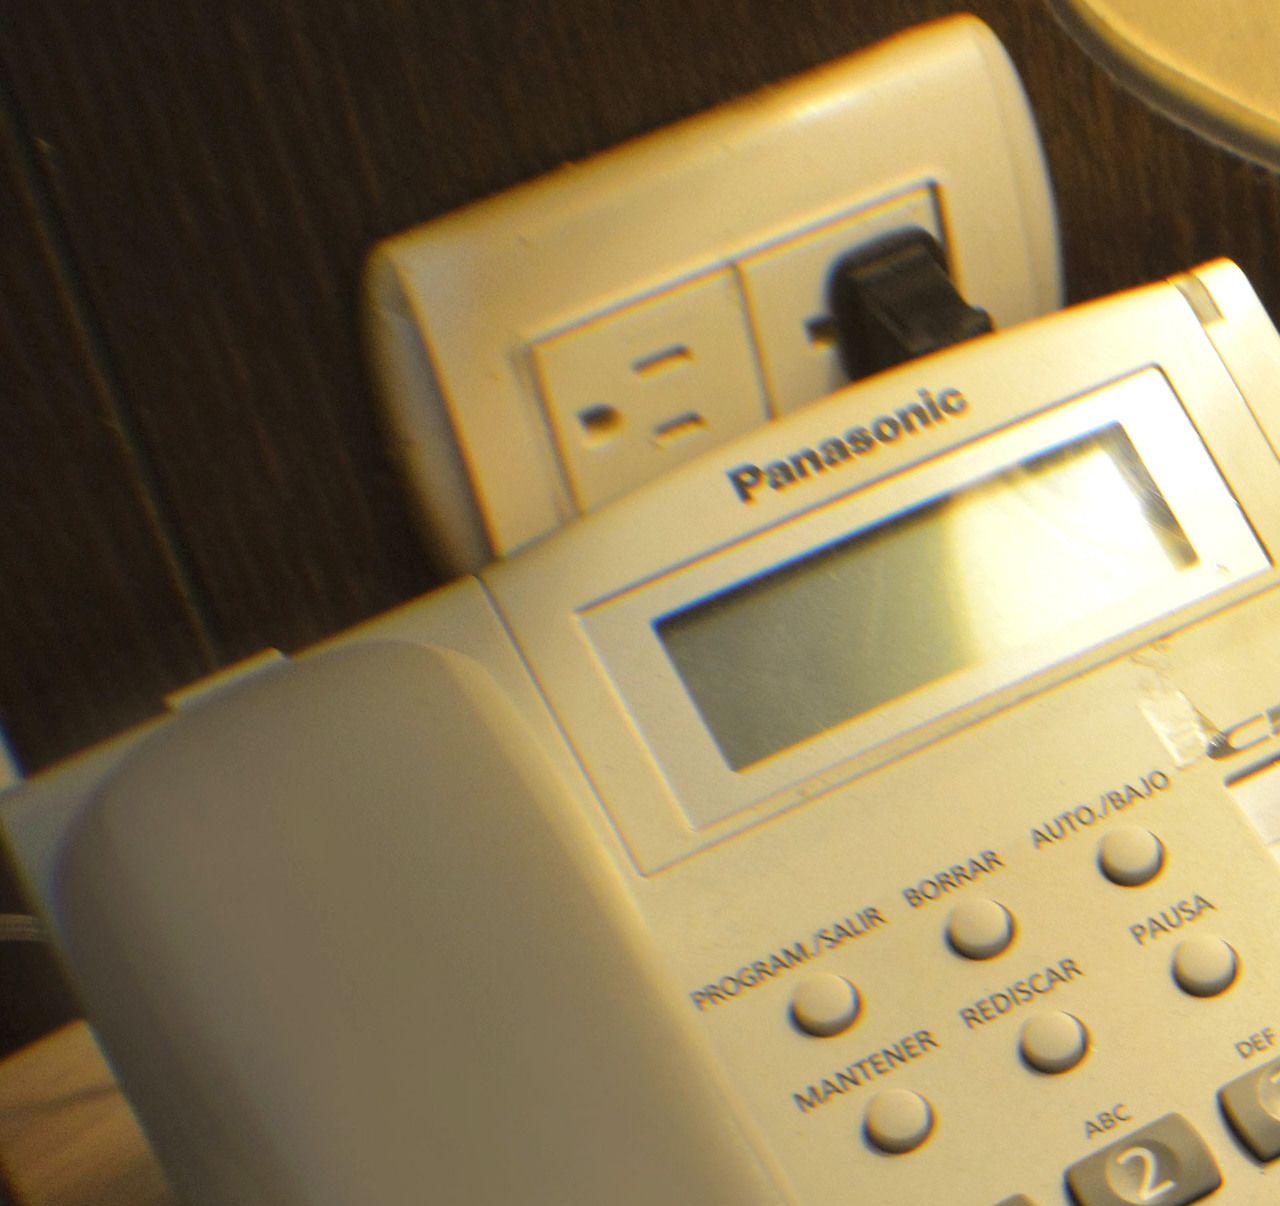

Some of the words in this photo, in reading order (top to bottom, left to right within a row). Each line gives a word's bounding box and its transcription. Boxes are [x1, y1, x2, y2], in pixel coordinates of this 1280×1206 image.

[728, 386, 970, 505] Panasonic
[1030, 770, 1171, 849] AUTO./BAJO
[902, 850, 1005, 908] BORRAR
[1129, 895, 1216, 945] PAUSA
[960, 958, 1084, 1028] REDISCAR
[794, 1029, 940, 1113] MANTENER
[1234, 1027, 1279, 1060] DEF
[1084, 1103, 1133, 1140] ABC
[1116, 1146, 1175, 1200] 2
